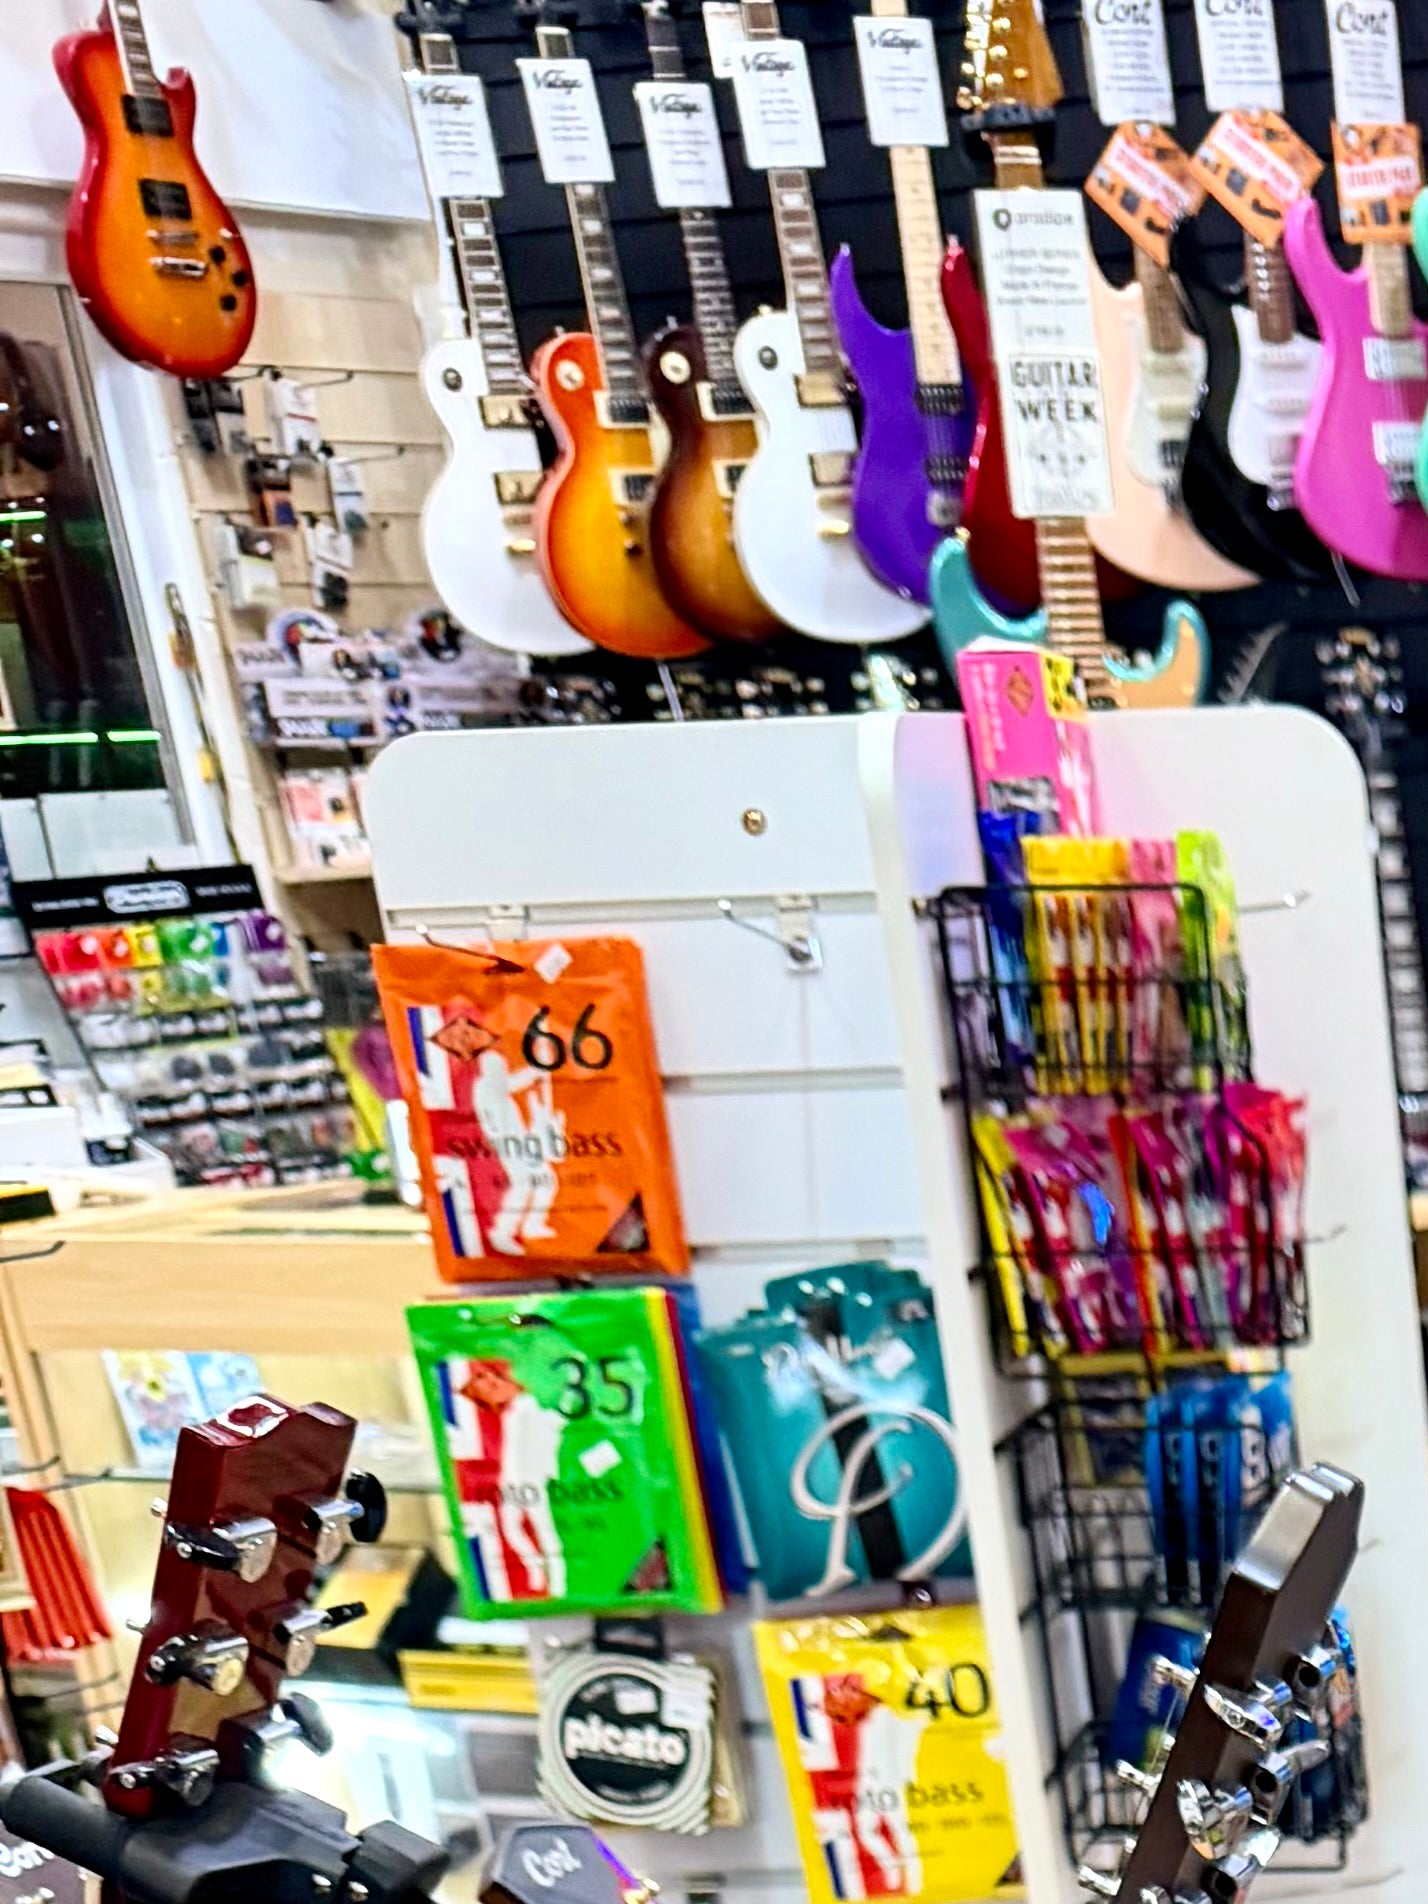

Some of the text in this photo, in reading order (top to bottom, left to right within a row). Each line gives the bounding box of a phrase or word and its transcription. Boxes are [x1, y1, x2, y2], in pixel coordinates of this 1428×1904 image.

[1010, 360, 1099, 389] GUITAR
[1014, 397, 1100, 422] WEEK
[521, 1003, 613, 1071] 66
[547, 1125, 624, 1158] bass
[551, 1355, 634, 1420] 35
[905, 1663, 992, 1719] 40
[565, 1712, 686, 1766] picato
[906, 1779, 986, 1808] bass
[521, 1838, 584, 1889] Cort
